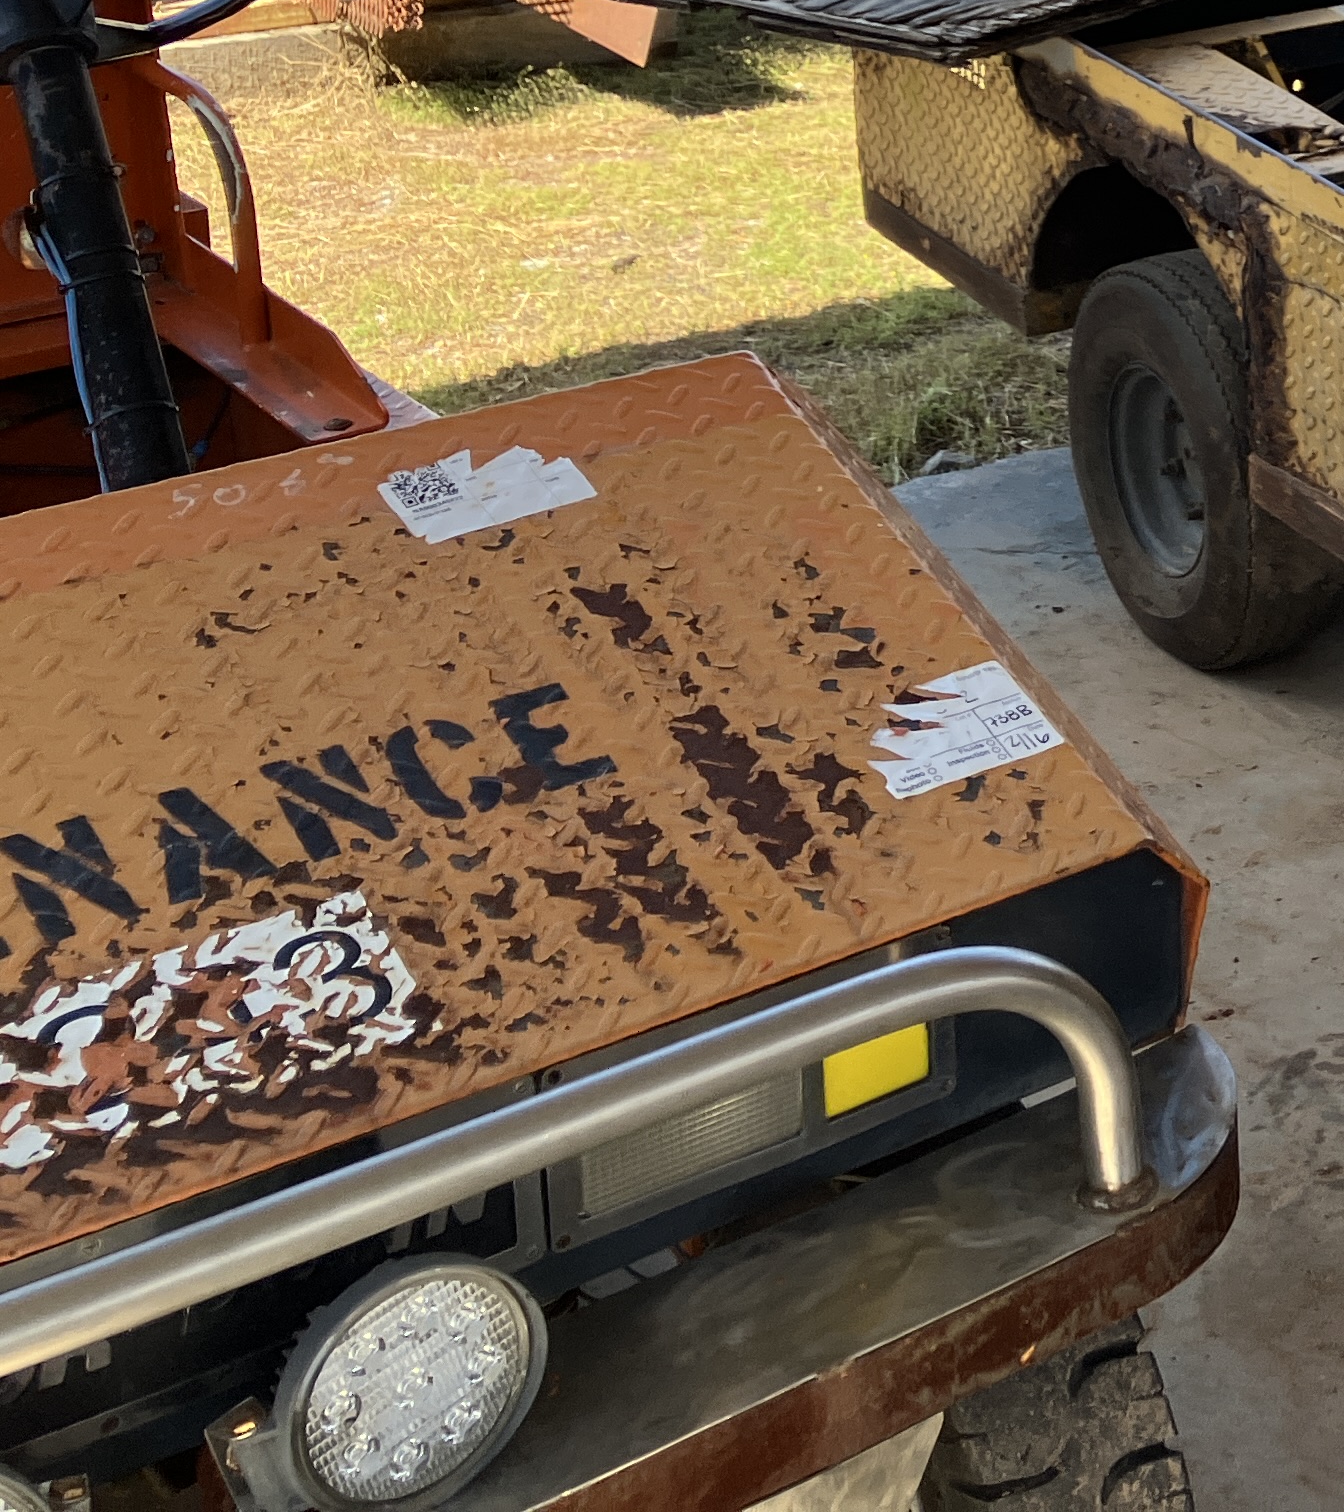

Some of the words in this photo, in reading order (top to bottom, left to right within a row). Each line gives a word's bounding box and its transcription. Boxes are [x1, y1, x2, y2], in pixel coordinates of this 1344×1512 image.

[946, 750, 991, 767] Inspection
[899, 771, 926, 783] Video
[0, 683, 617, 962] NANCE
